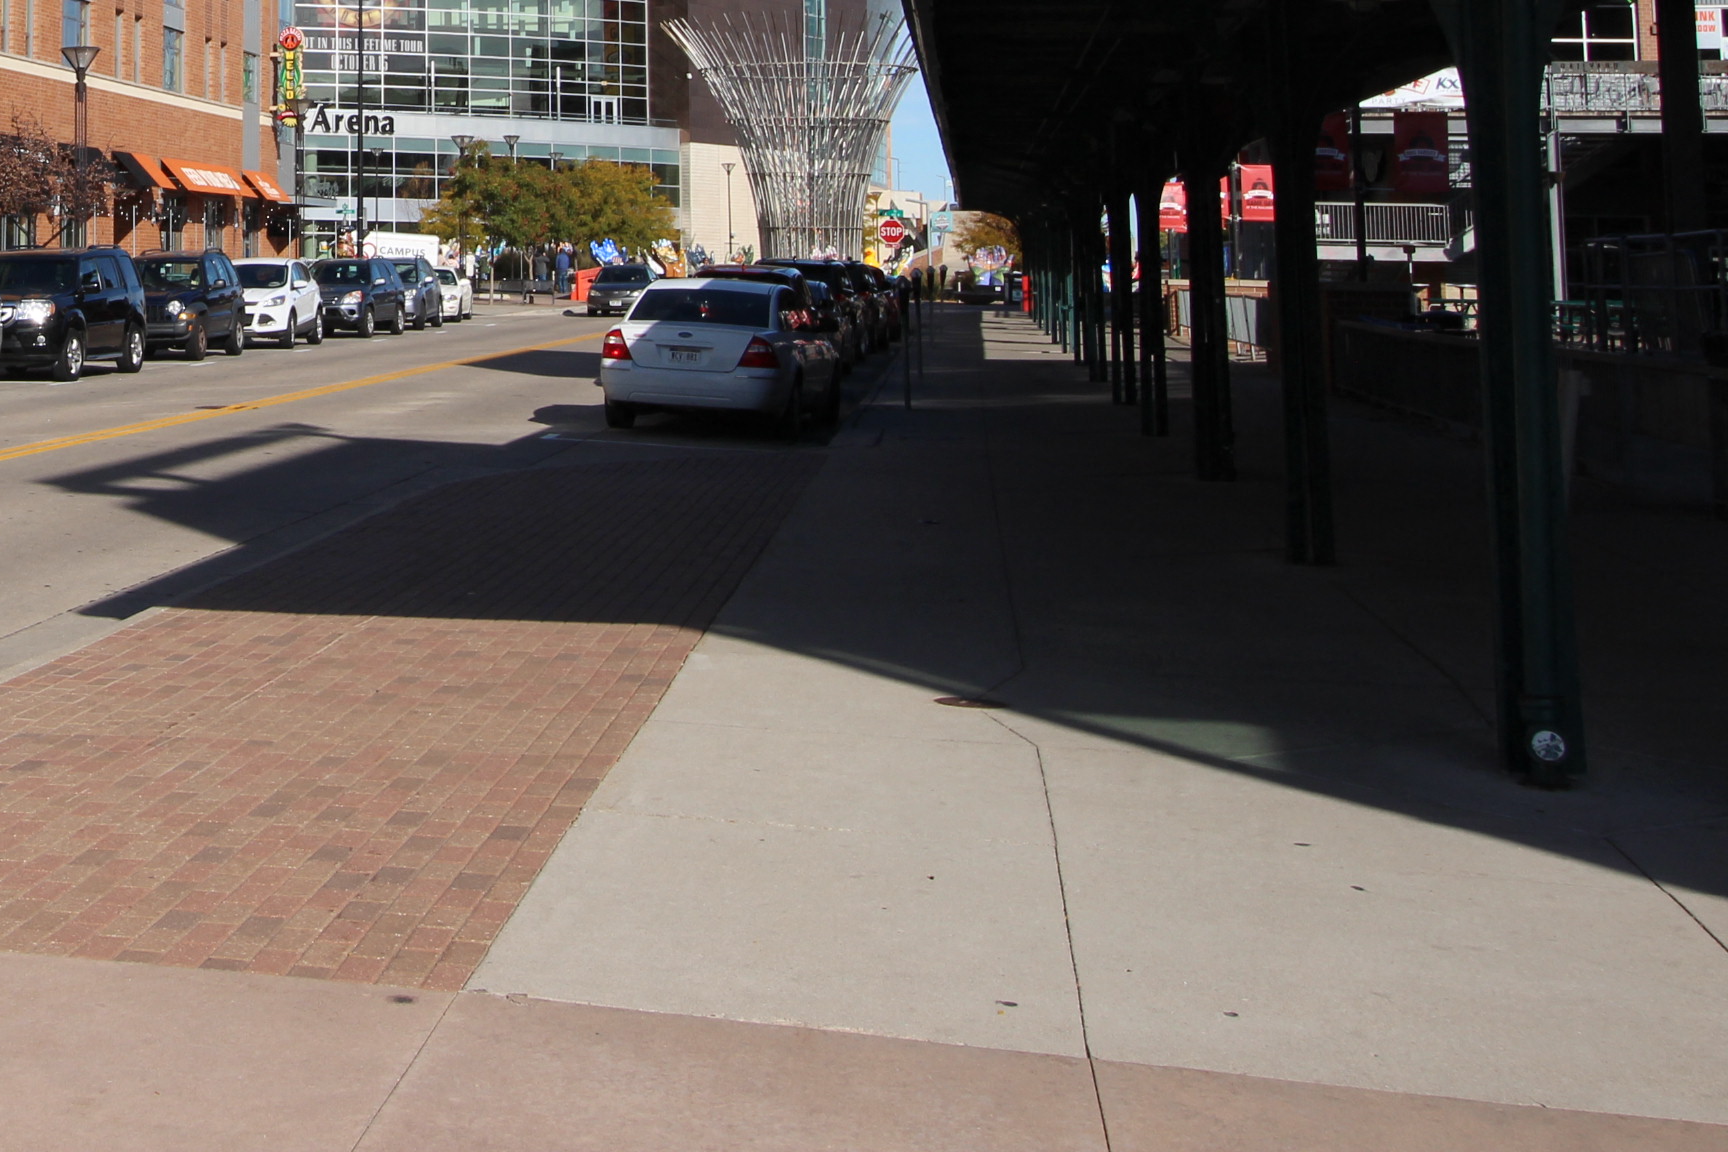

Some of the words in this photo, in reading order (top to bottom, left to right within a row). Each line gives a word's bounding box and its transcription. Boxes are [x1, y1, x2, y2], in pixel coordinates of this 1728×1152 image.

[318, 37, 328, 49] IN
[355, 38, 397, 52] LFETIME
[400, 40, 423, 53] TOUR
[1371, 97, 1406, 105] PARTY
[309, 104, 395, 135] Arena
[880, 227, 903, 237] STOP
[379, 246, 426, 257] CAMPUS
